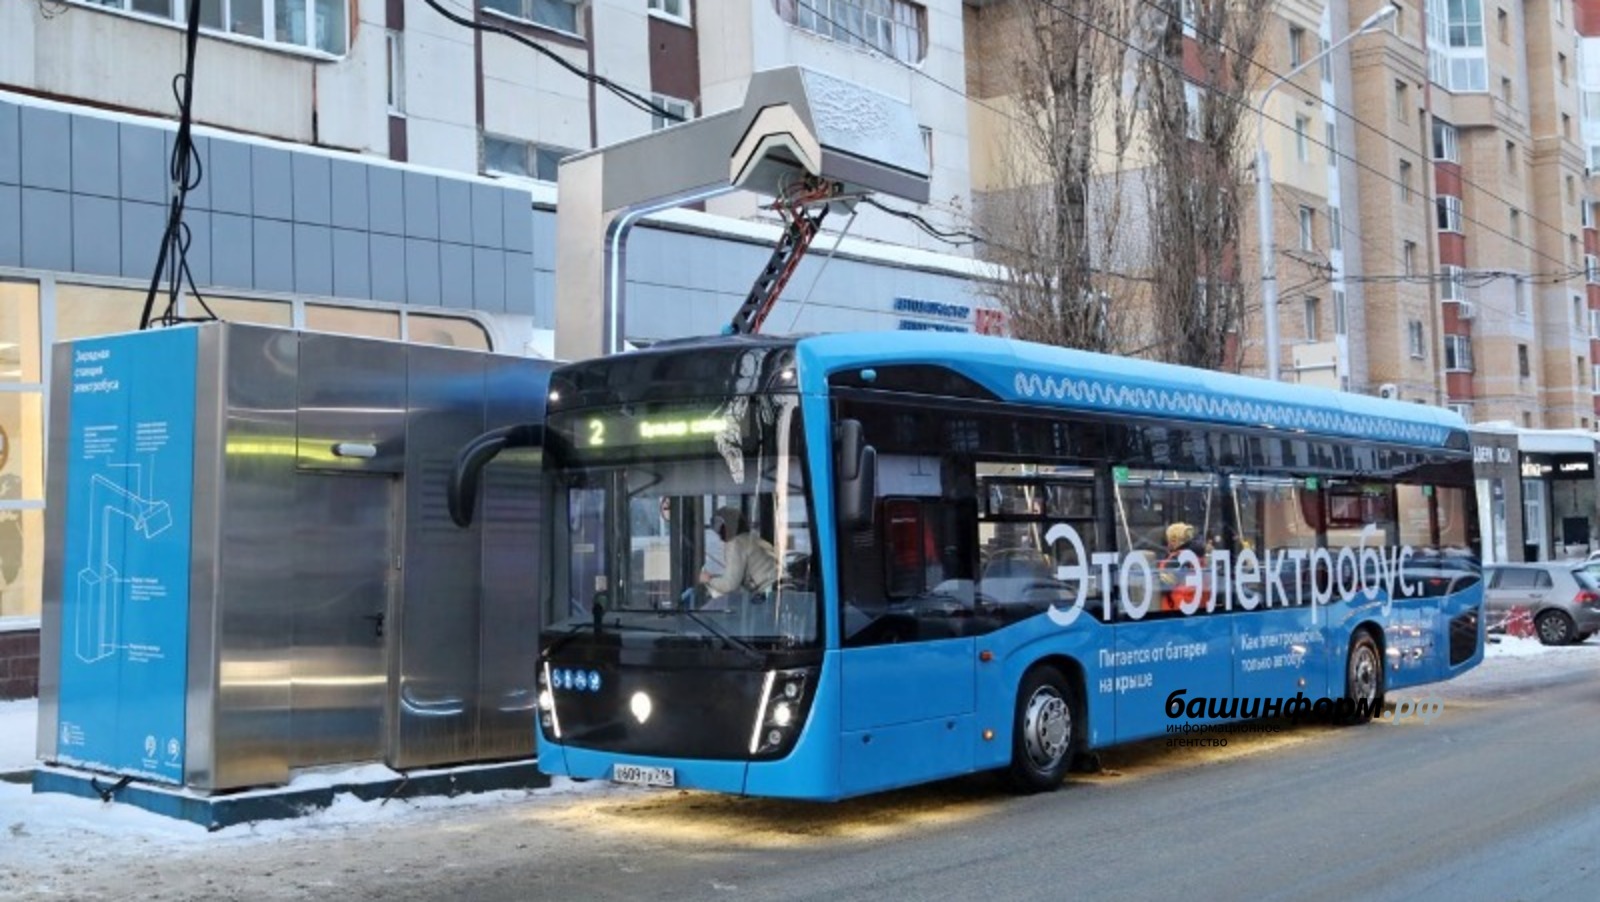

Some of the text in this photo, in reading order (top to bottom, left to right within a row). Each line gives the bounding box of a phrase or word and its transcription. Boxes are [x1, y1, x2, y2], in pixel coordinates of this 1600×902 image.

[588, 418, 605, 446] 2
[1044, 522, 1424, 628] Это электробус.
[1099, 641, 1208, 669] Питается от батареи
[1241, 632, 1259, 651] Как
[1099, 672, 1153, 695] на крыше
